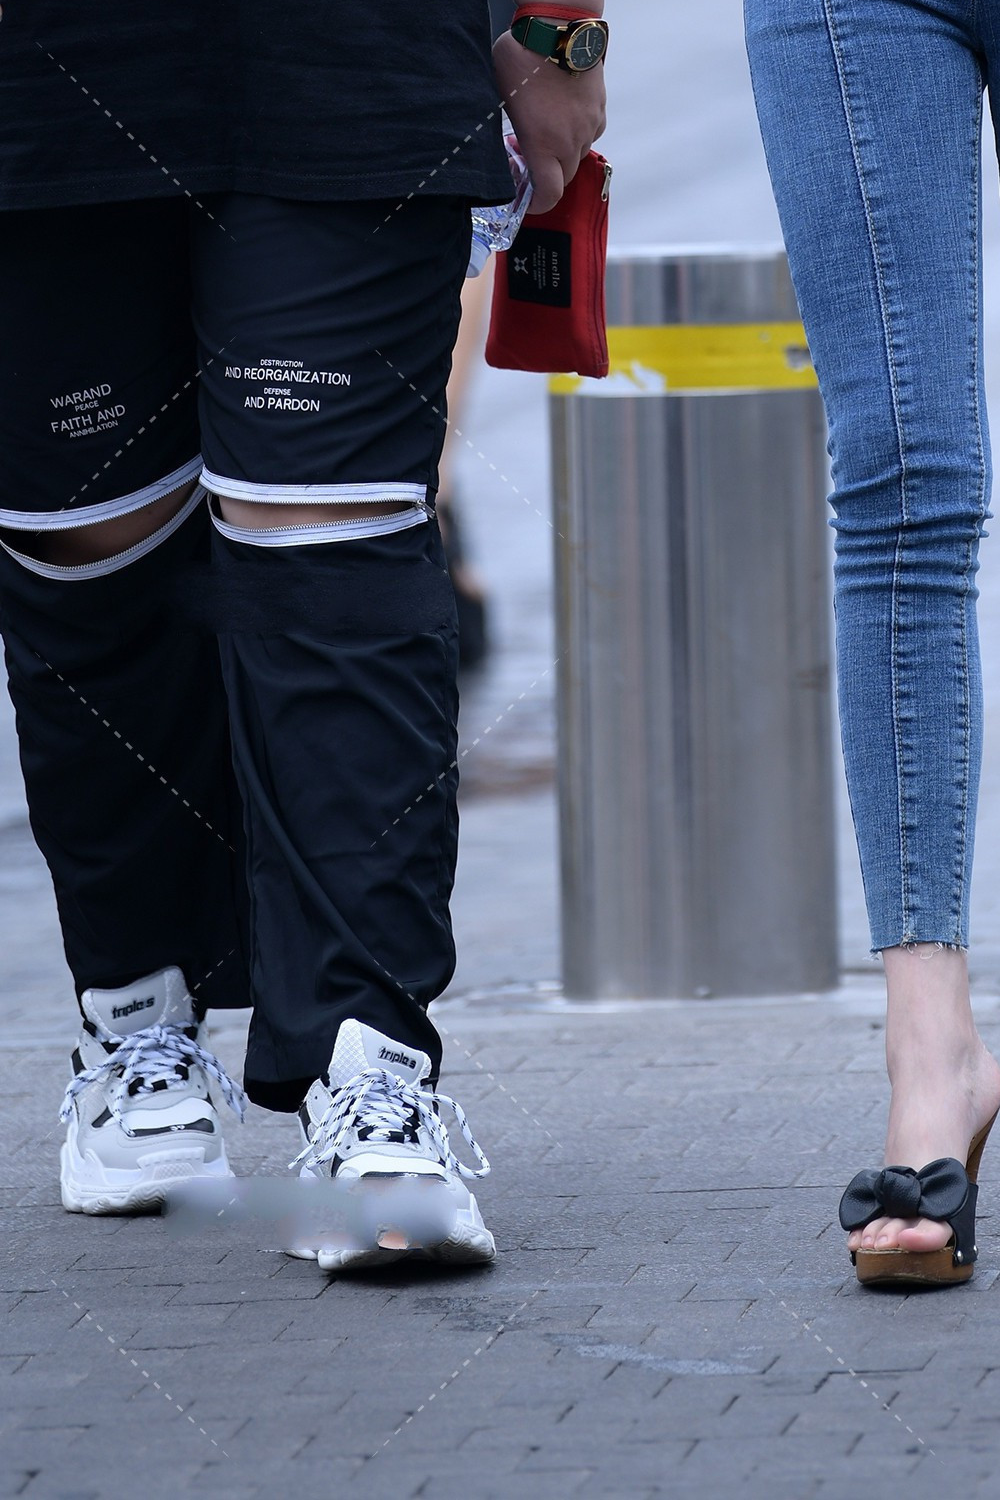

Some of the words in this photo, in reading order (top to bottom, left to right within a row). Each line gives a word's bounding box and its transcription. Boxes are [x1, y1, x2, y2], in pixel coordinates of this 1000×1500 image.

[551, 251, 560, 288] anello
[260, 359, 304, 368] DESTRUCTION
[224, 366, 242, 379] AND
[244, 367, 351, 386] REORGANIZATION
[263, 387, 292, 396] DEFENSE
[74, 400, 99, 412] PEACE
[244, 396, 265, 409] AND
[267, 397, 320, 412] PARDON
[51, 414, 93, 433] FAITH
[97, 404, 126, 423] AND
[69, 420, 119, 438] ANNIHILATION
